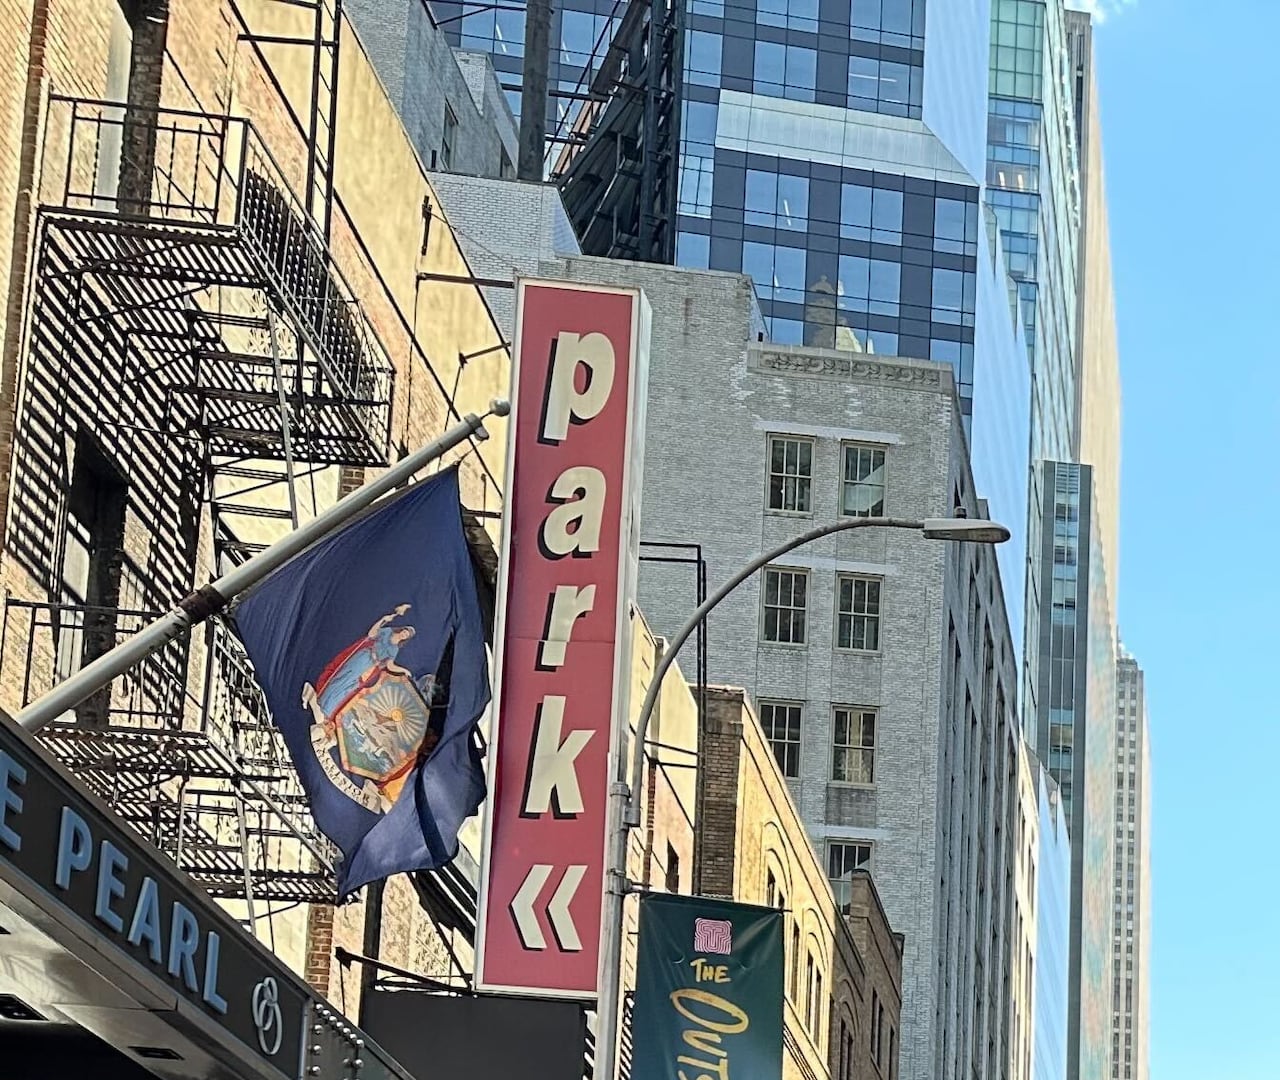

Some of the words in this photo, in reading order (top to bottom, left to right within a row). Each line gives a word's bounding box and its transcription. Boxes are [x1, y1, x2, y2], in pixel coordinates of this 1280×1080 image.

[527, 327, 617, 817] park
[56, 806, 228, 1014] PEARL
[690, 958, 731, 983] THE
